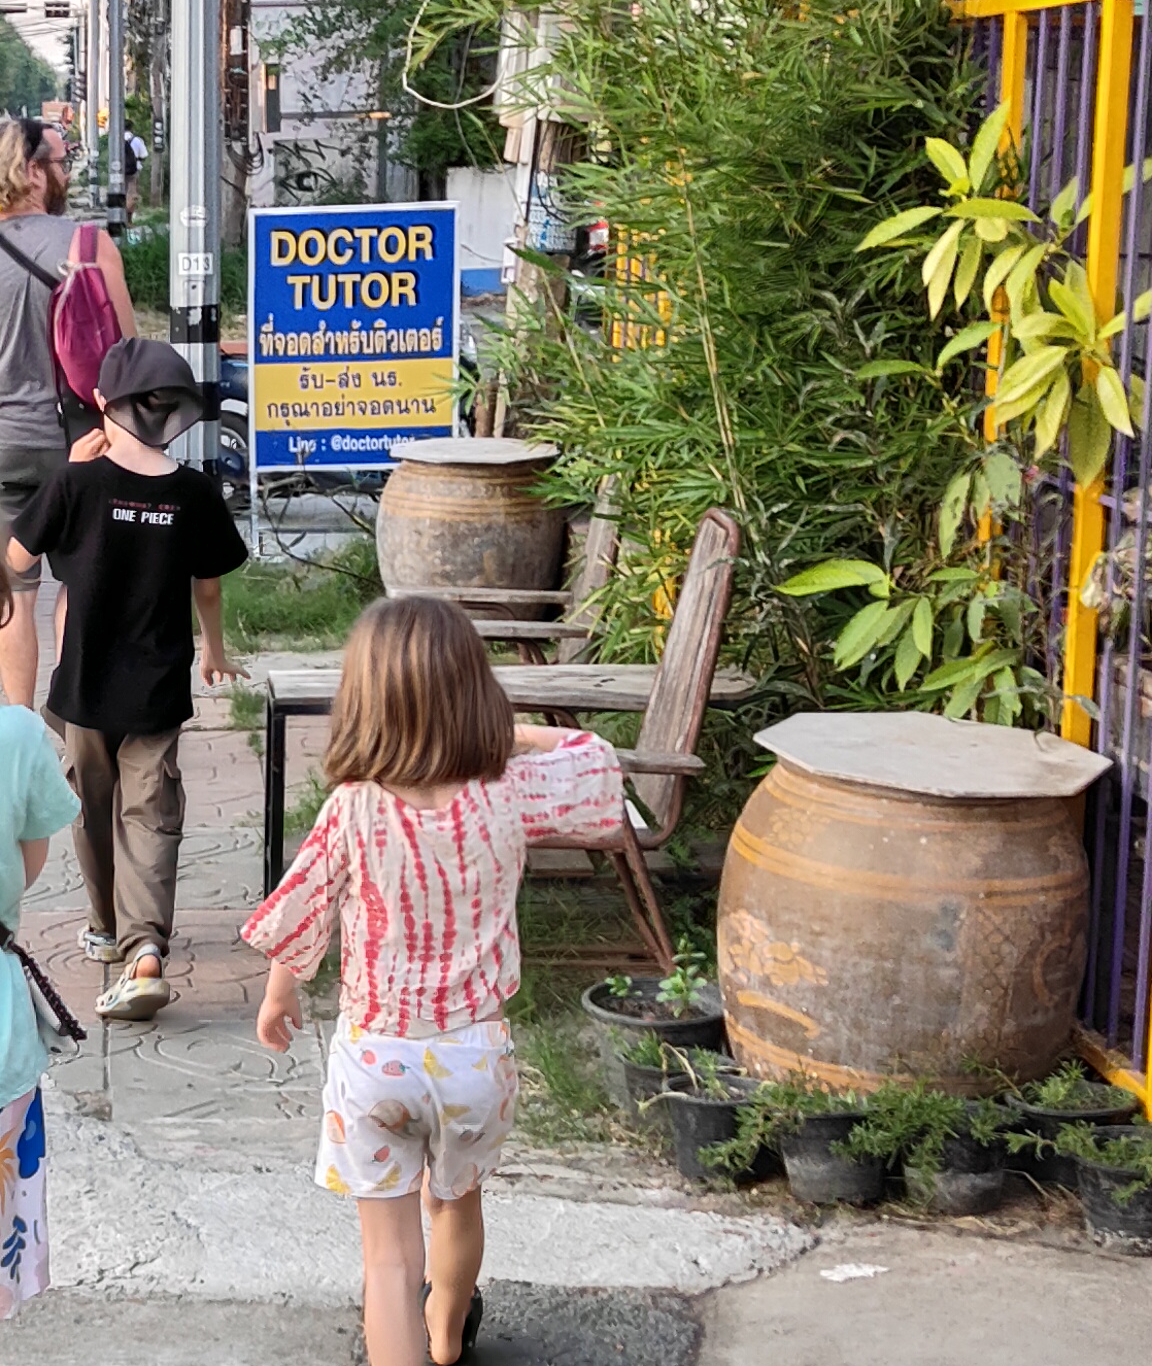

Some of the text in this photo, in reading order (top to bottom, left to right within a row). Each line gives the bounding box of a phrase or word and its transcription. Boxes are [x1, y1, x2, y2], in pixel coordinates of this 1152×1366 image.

[270, 225, 435, 267] DOCTOR
[286, 271, 417, 310] TUTOR
[266, 394, 437, 427] กรุณาอย่าจอดนาน
[112, 508, 175, 525] ONE PIECE
